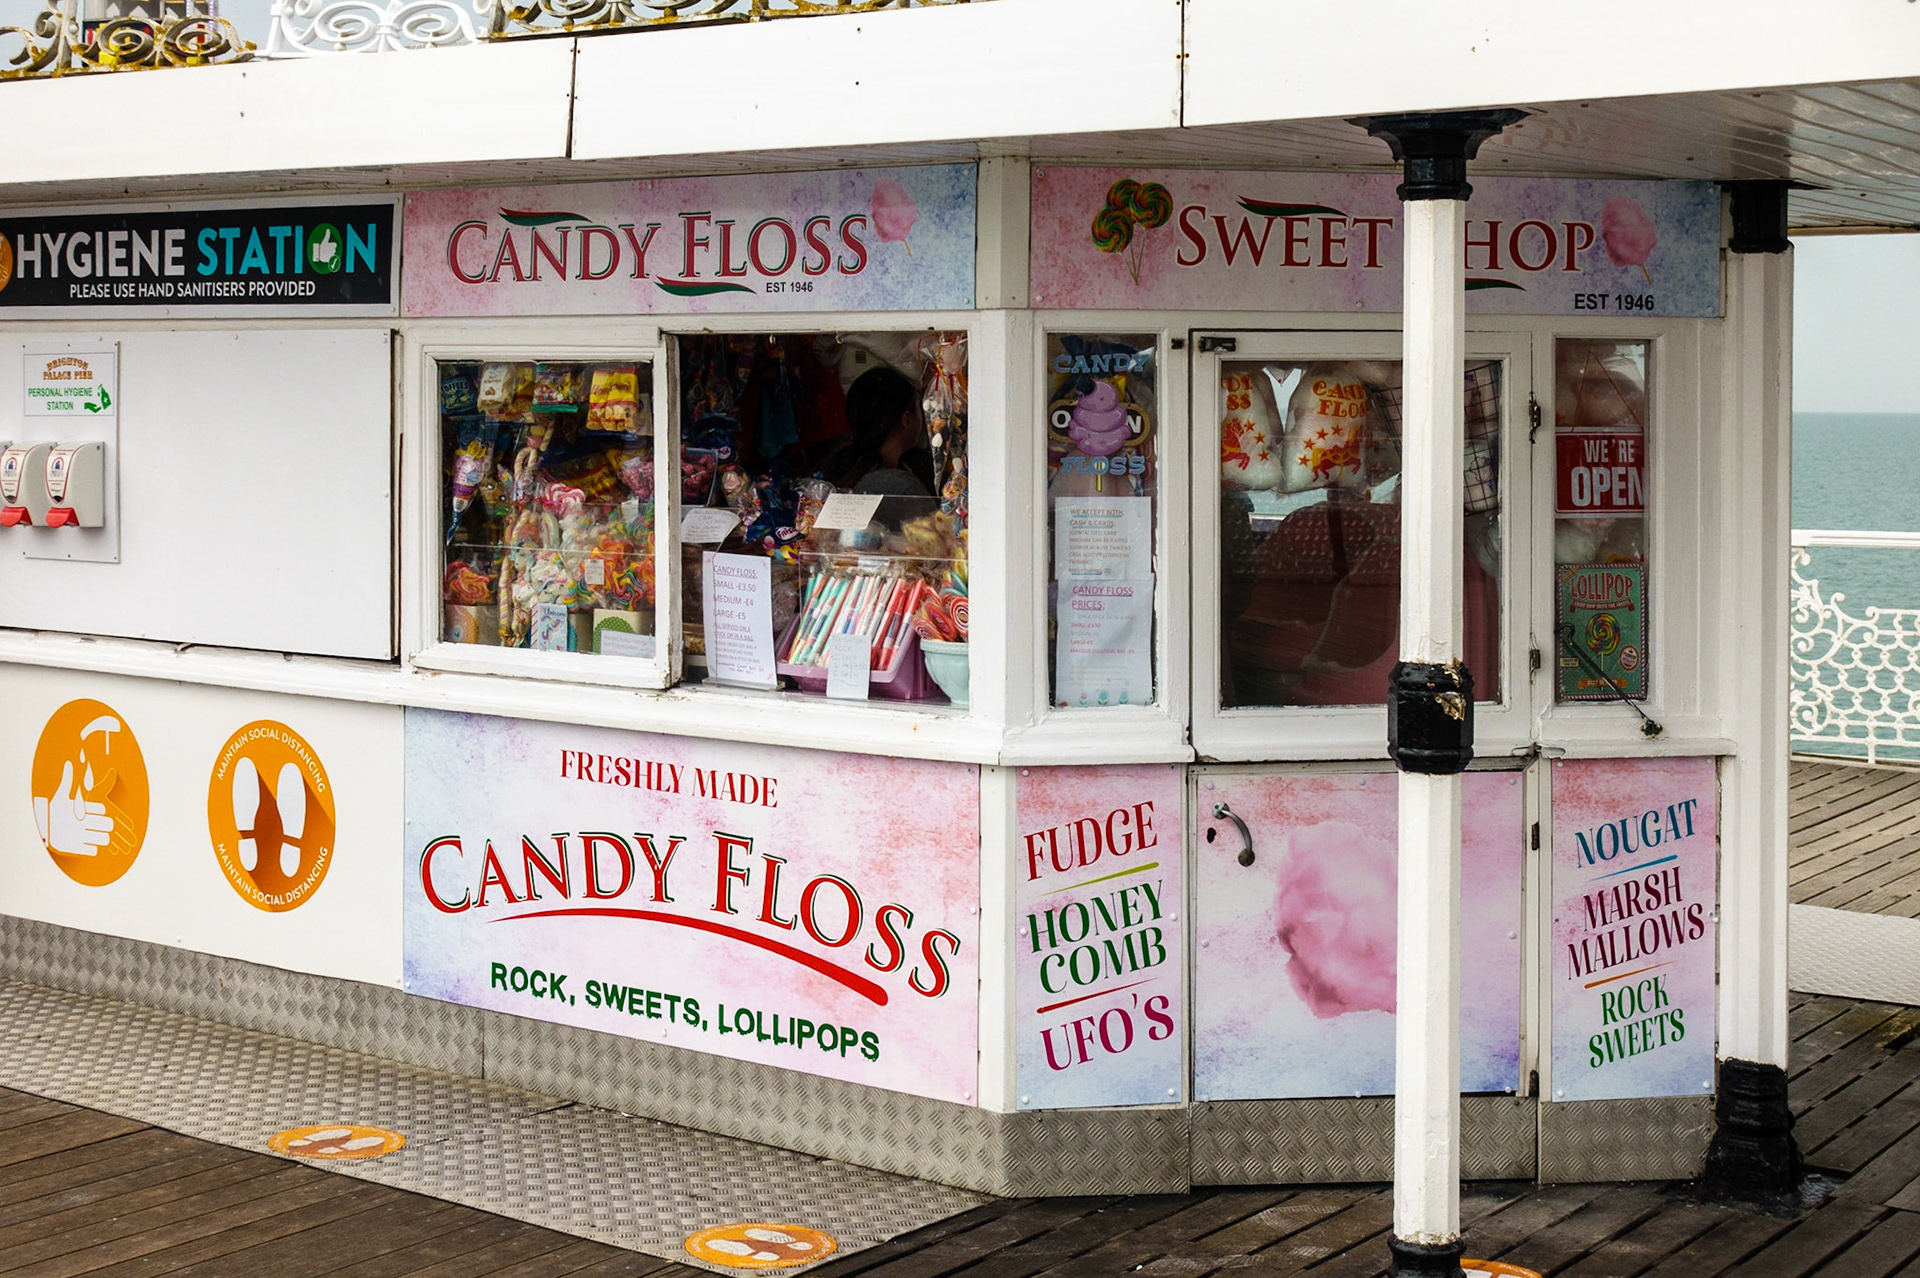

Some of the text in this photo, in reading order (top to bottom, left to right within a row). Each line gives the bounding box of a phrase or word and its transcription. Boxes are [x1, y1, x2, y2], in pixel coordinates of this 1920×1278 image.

[16, 228, 186, 279] HYGIENE
[447, 211, 870, 285] CANDY FLOSS
[1176, 205, 1595, 272] SWEET HOP
[70, 280, 316, 299] PLEASE USE HAND SANITISERS PROVIDED
[766, 281, 814, 293] EST 1946
[1574, 293, 1655, 312] EST 1946
[28, 387, 93, 397] PERSONAL HYGIENE
[1053, 353, 1149, 374] CANDY
[46, 401, 74, 411] STATION
[1051, 410, 1142, 434] ON
[1061, 455, 1146, 476] FLOSS
[1584, 439, 1635, 463] WE'RE
[713, 565, 735, 574] CANDY
[713, 581, 735, 590] SMALL
[1072, 586, 1134, 596] CANDY FLOSS
[1570, 572, 1633, 601] LOLLIPOP
[217, 727, 326, 793] MAINTAIN SOCIAL DISTANCING
[560, 749, 779, 810] FRESHLY MADE
[1024, 800, 1158, 882] FUDGE
[1575, 798, 1697, 868] NOUGAT
[218, 843, 328, 906] MAINTAIN SOCIAL DISTANCING
[1583, 866, 1683, 932] MARSH
[418, 830, 962, 1000] CANDY FLOSS
[1026, 879, 1163, 954] HONEY
[1567, 903, 1705, 980] MALLOWS
[1040, 926, 1167, 994] COMB
[490, 961, 881, 1062] ROCK, SWEETS, LOLLIPOPS
[1601, 974, 1669, 1027] ROCK
[1039, 993, 1174, 1071] UFO'S
[1589, 1008, 1685, 1069] SWEETS
